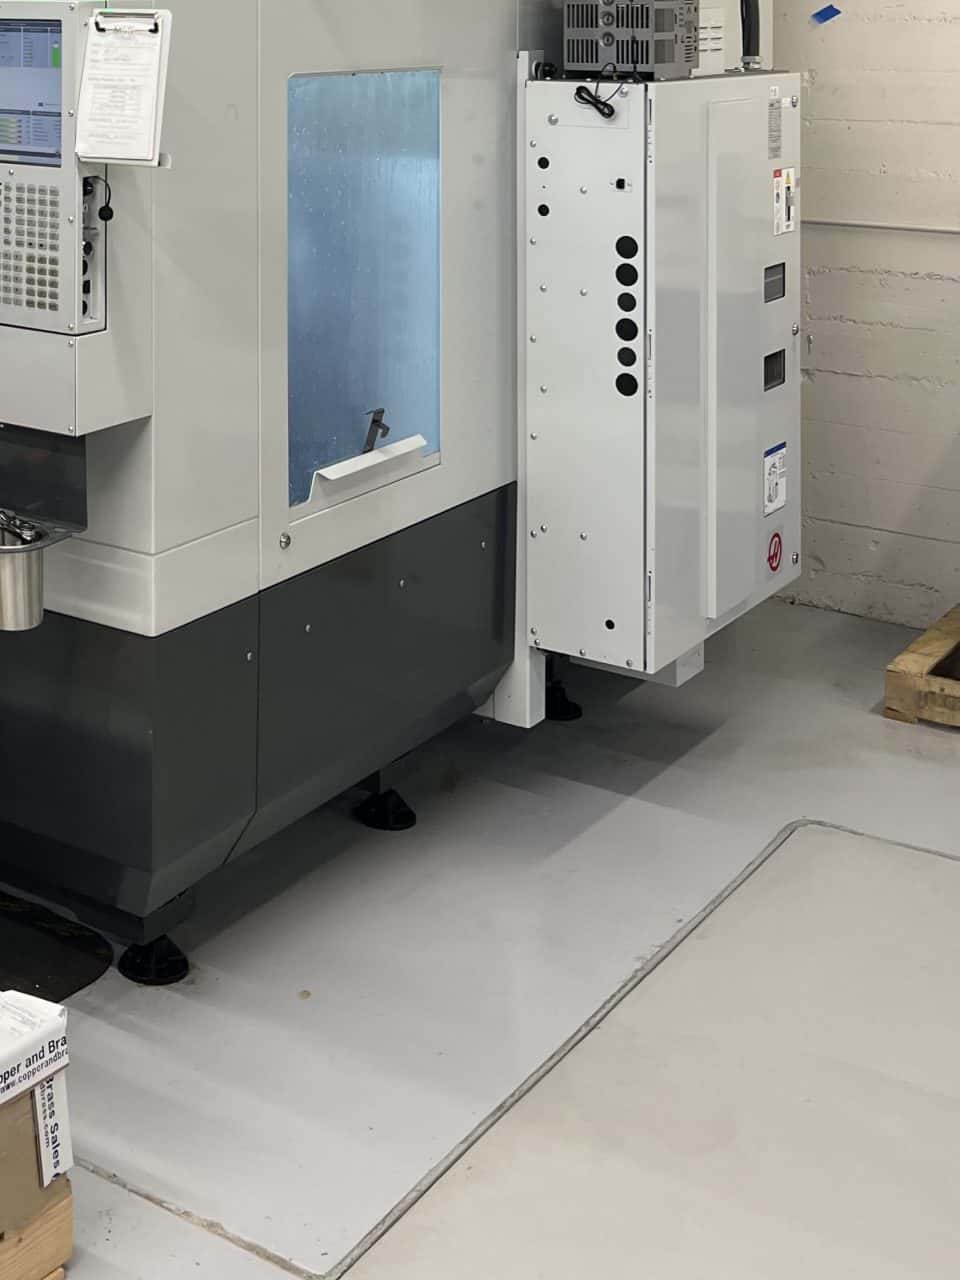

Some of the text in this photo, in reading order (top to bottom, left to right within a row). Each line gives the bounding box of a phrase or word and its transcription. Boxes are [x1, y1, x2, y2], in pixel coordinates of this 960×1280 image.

[25, 1046, 45, 1069] and
[48, 1035, 67, 1055] Bra
[50, 1122, 61, 1169] Sales
